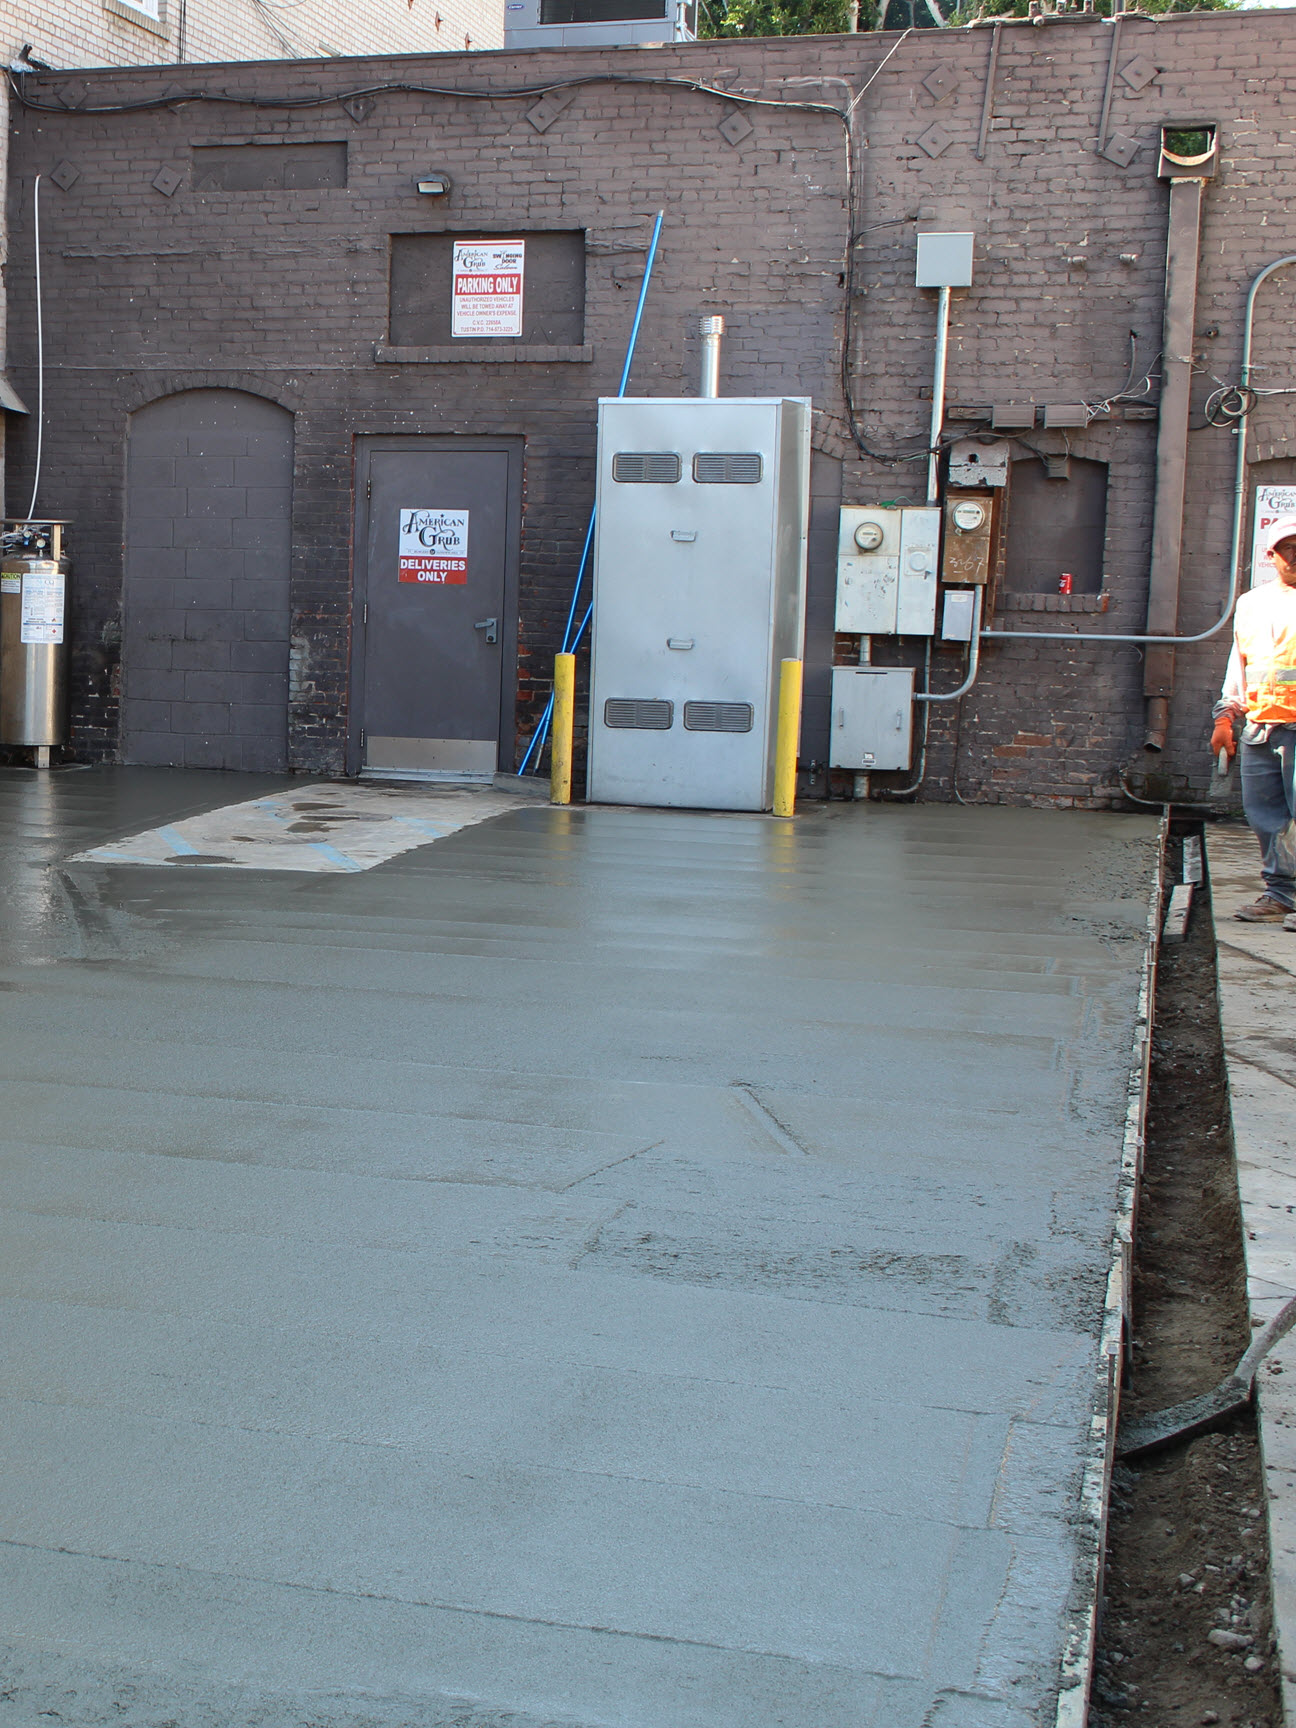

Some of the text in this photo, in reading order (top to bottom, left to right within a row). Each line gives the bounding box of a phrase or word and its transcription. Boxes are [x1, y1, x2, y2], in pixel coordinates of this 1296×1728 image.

[457, 276, 519, 293] PARKING ONLY
[402, 510, 464, 535] AMERICAN
[400, 558, 466, 571] DELIVERIES
[417, 571, 448, 582] ONLY
